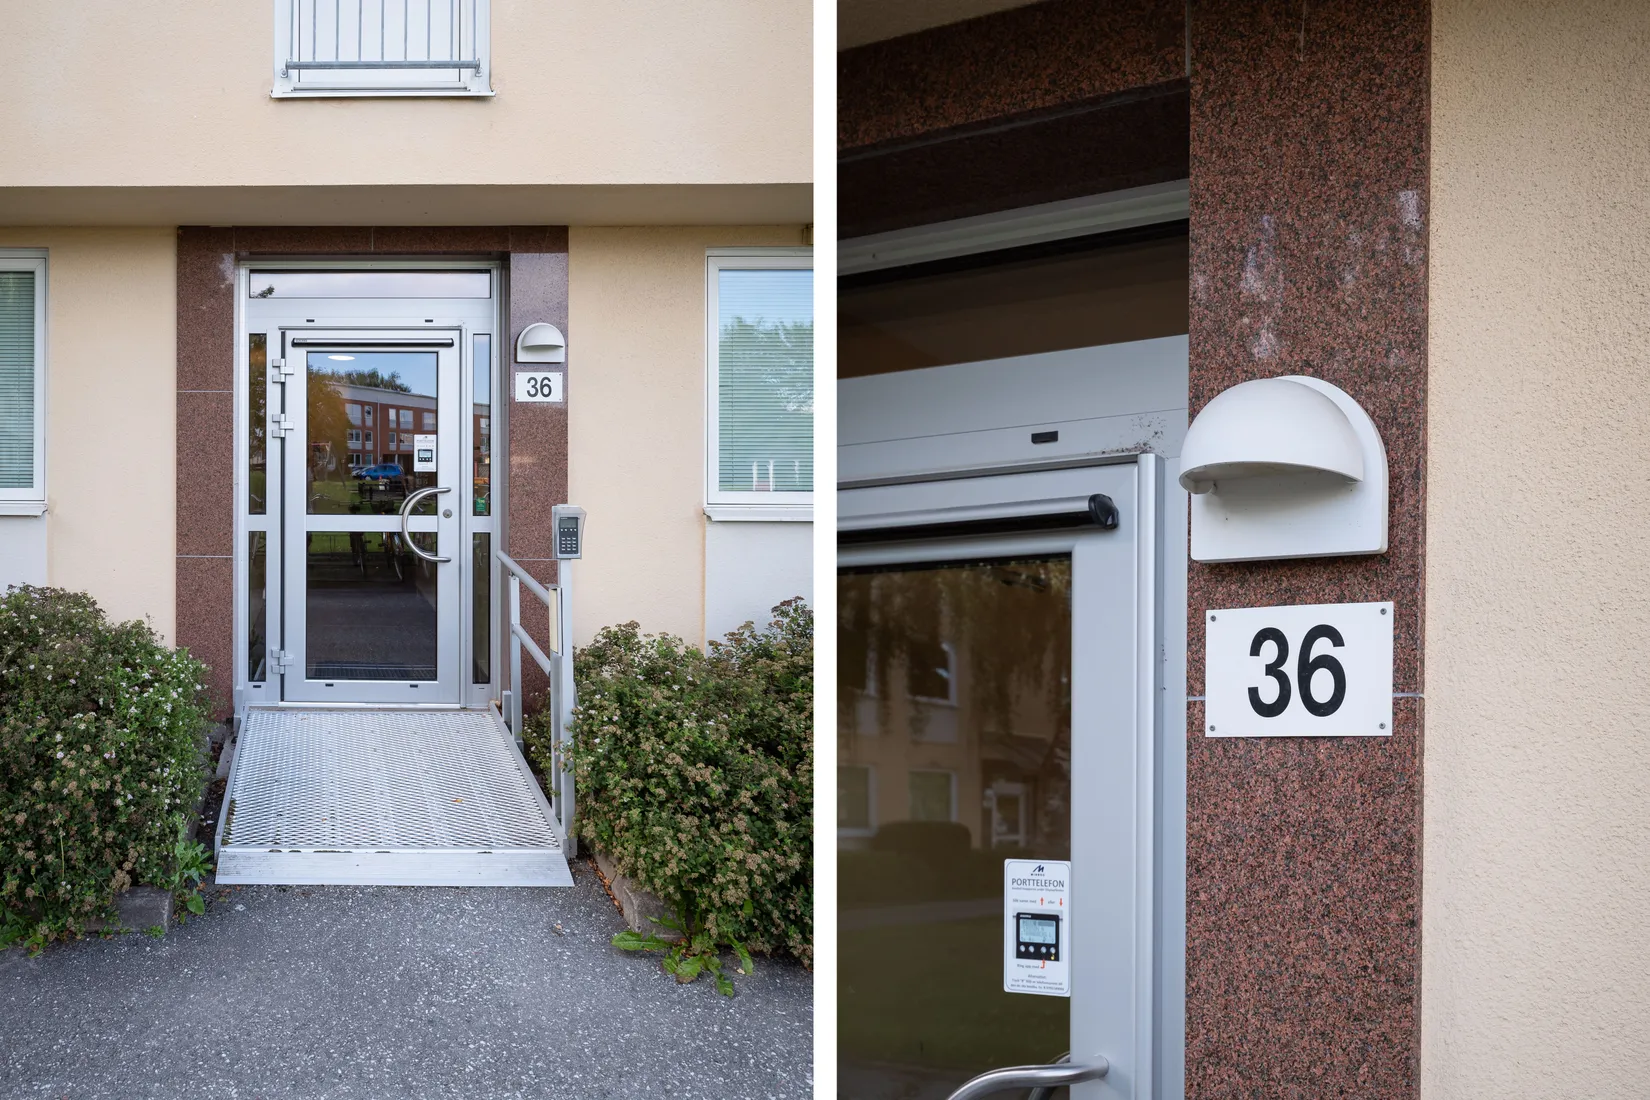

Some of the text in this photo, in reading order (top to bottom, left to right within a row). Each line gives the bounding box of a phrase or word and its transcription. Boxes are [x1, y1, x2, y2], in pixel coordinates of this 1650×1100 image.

[527, 376, 552, 398] 36
[1247, 624, 1347, 718] 36
[1011, 878, 1065, 888] PORTTELEFON
